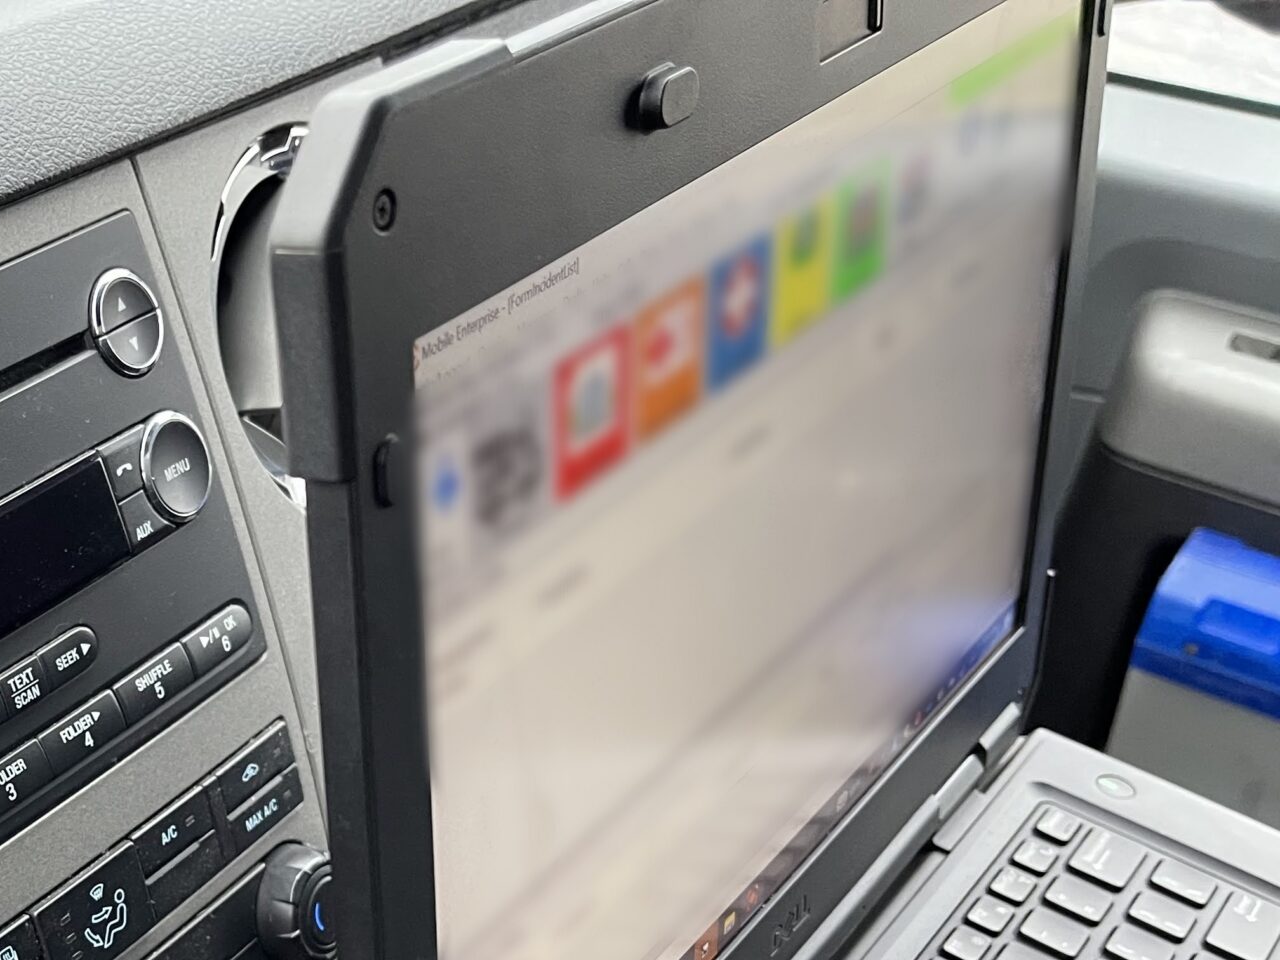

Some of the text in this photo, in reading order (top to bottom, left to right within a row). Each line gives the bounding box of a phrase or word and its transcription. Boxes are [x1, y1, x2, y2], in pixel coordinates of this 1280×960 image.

[421, 330, 455, 360] Mobile
[456, 308, 501, 342] Enterprise
[164, 458, 190, 481] MENU
[136, 521, 154, 541] AUX
[223, 614, 237, 632] OK
[221, 635, 232, 652] 6
[55, 648, 80, 672] SEEK
[7, 667, 35, 693] TEXT
[134, 658, 173, 692] SHUFFLE
[14, 684, 41, 709] SCAN
[154, 682, 165, 700] 5
[59, 713, 94, 744] FOLDER
[84, 730, 94, 749] 4
[5, 783, 17, 801] 3
[245, 798, 279, 832] MAX A/C
[161, 825, 178, 846] A/C
